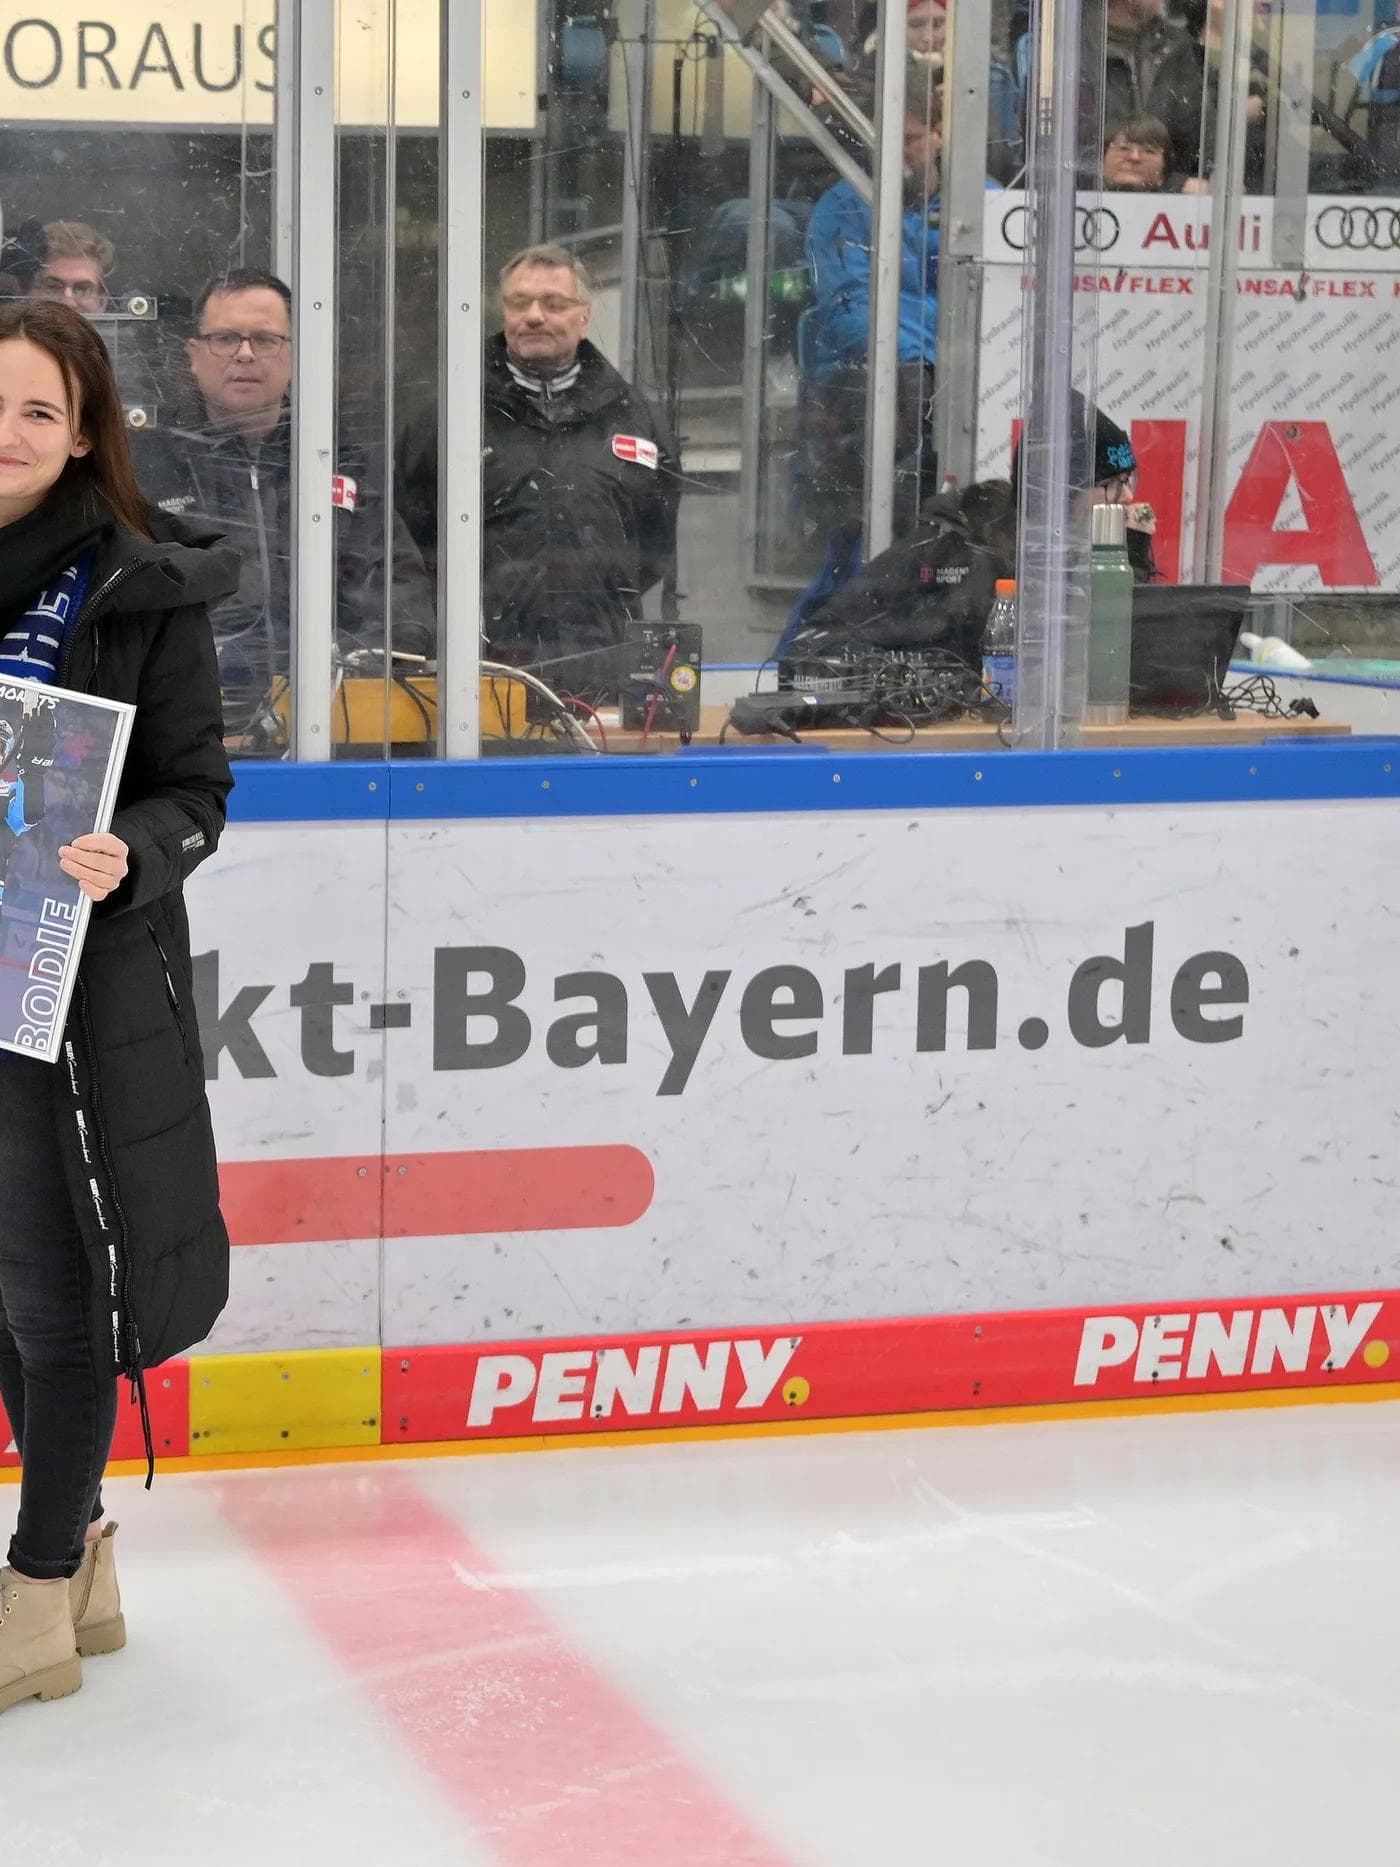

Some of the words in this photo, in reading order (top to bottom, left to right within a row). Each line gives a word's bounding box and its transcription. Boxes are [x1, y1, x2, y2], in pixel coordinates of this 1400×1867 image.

[1141, 212, 1262, 251] Aui
[14, 897, 79, 1051] BODIE
[200, 919, 1250, 1097] kt-Bayern.de
